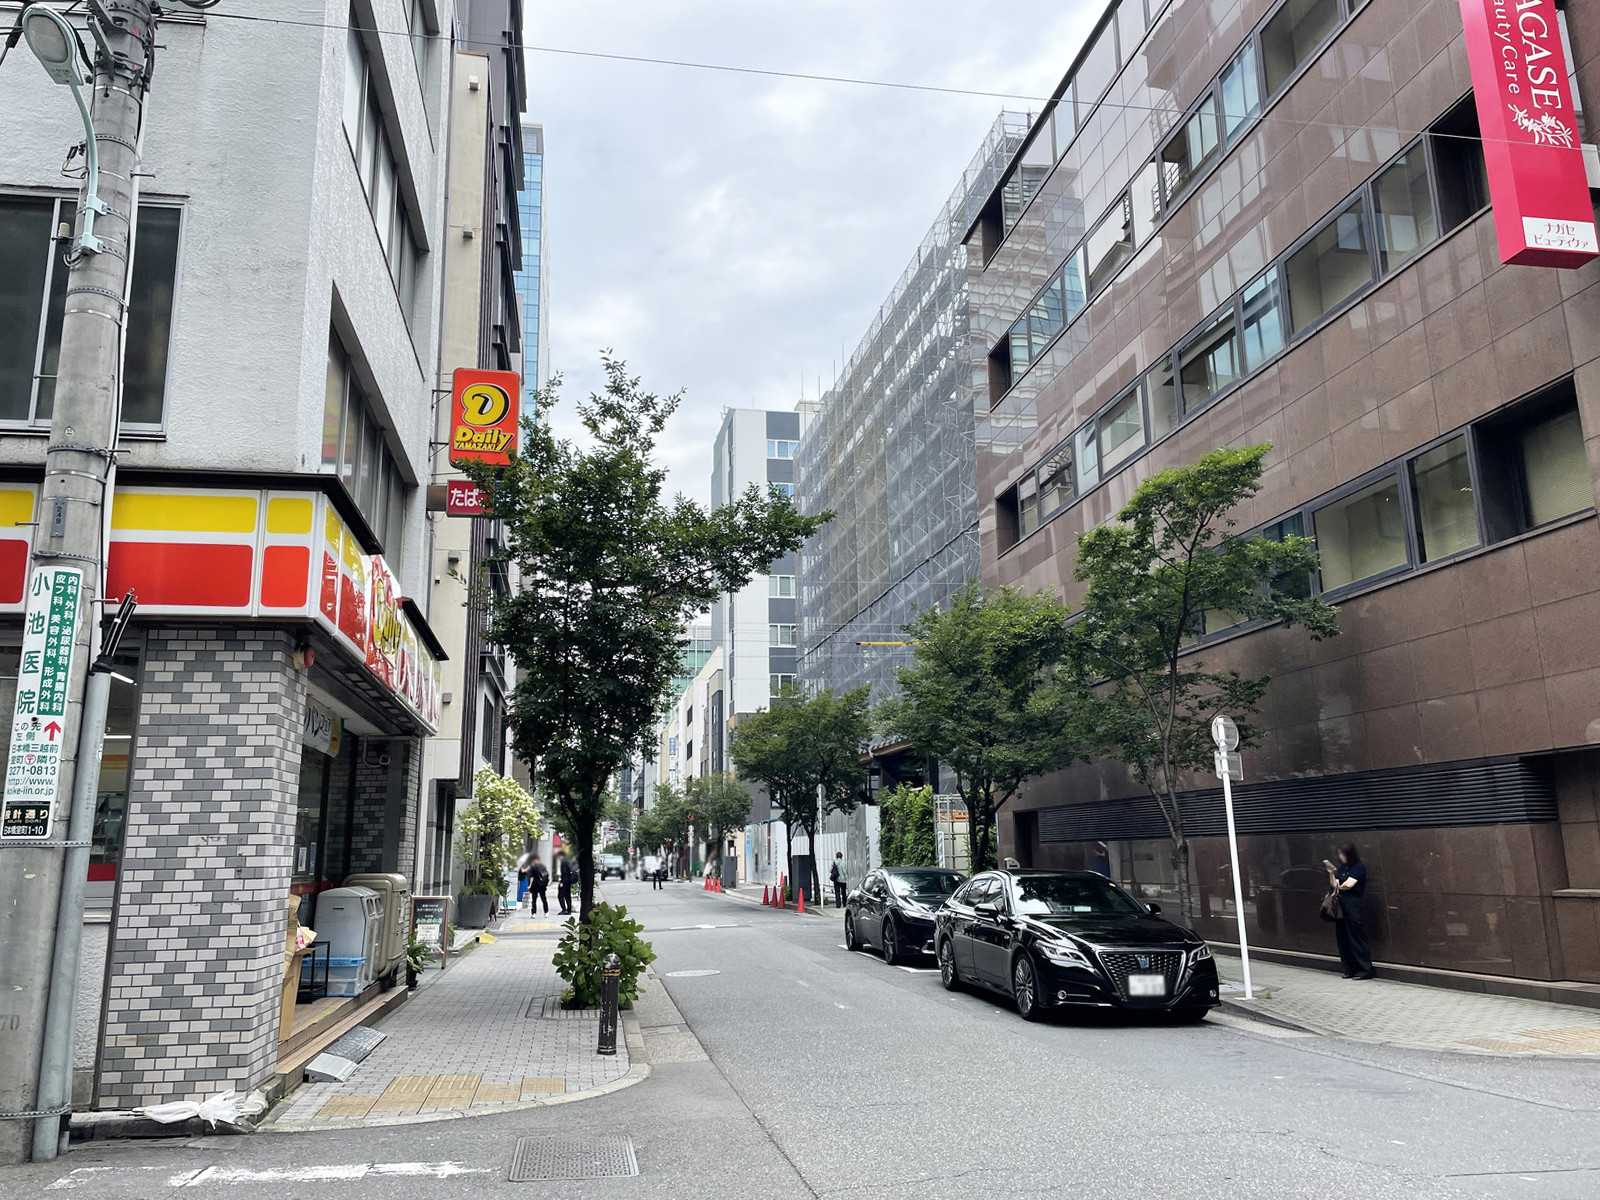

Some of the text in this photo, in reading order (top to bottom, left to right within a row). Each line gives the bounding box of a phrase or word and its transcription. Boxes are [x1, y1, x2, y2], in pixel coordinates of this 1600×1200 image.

[1544, 222, 1575, 236] ナガセ
[455, 426, 513, 452] Daily
[455, 441, 496, 451] YAMAZAKI
[17, 572, 50, 715] 小池医院
[16, 732, 35, 741] 左側
[12, 743, 59, 754] 日本橋三越前
[9, 765, 56, 776] 3271-0813
